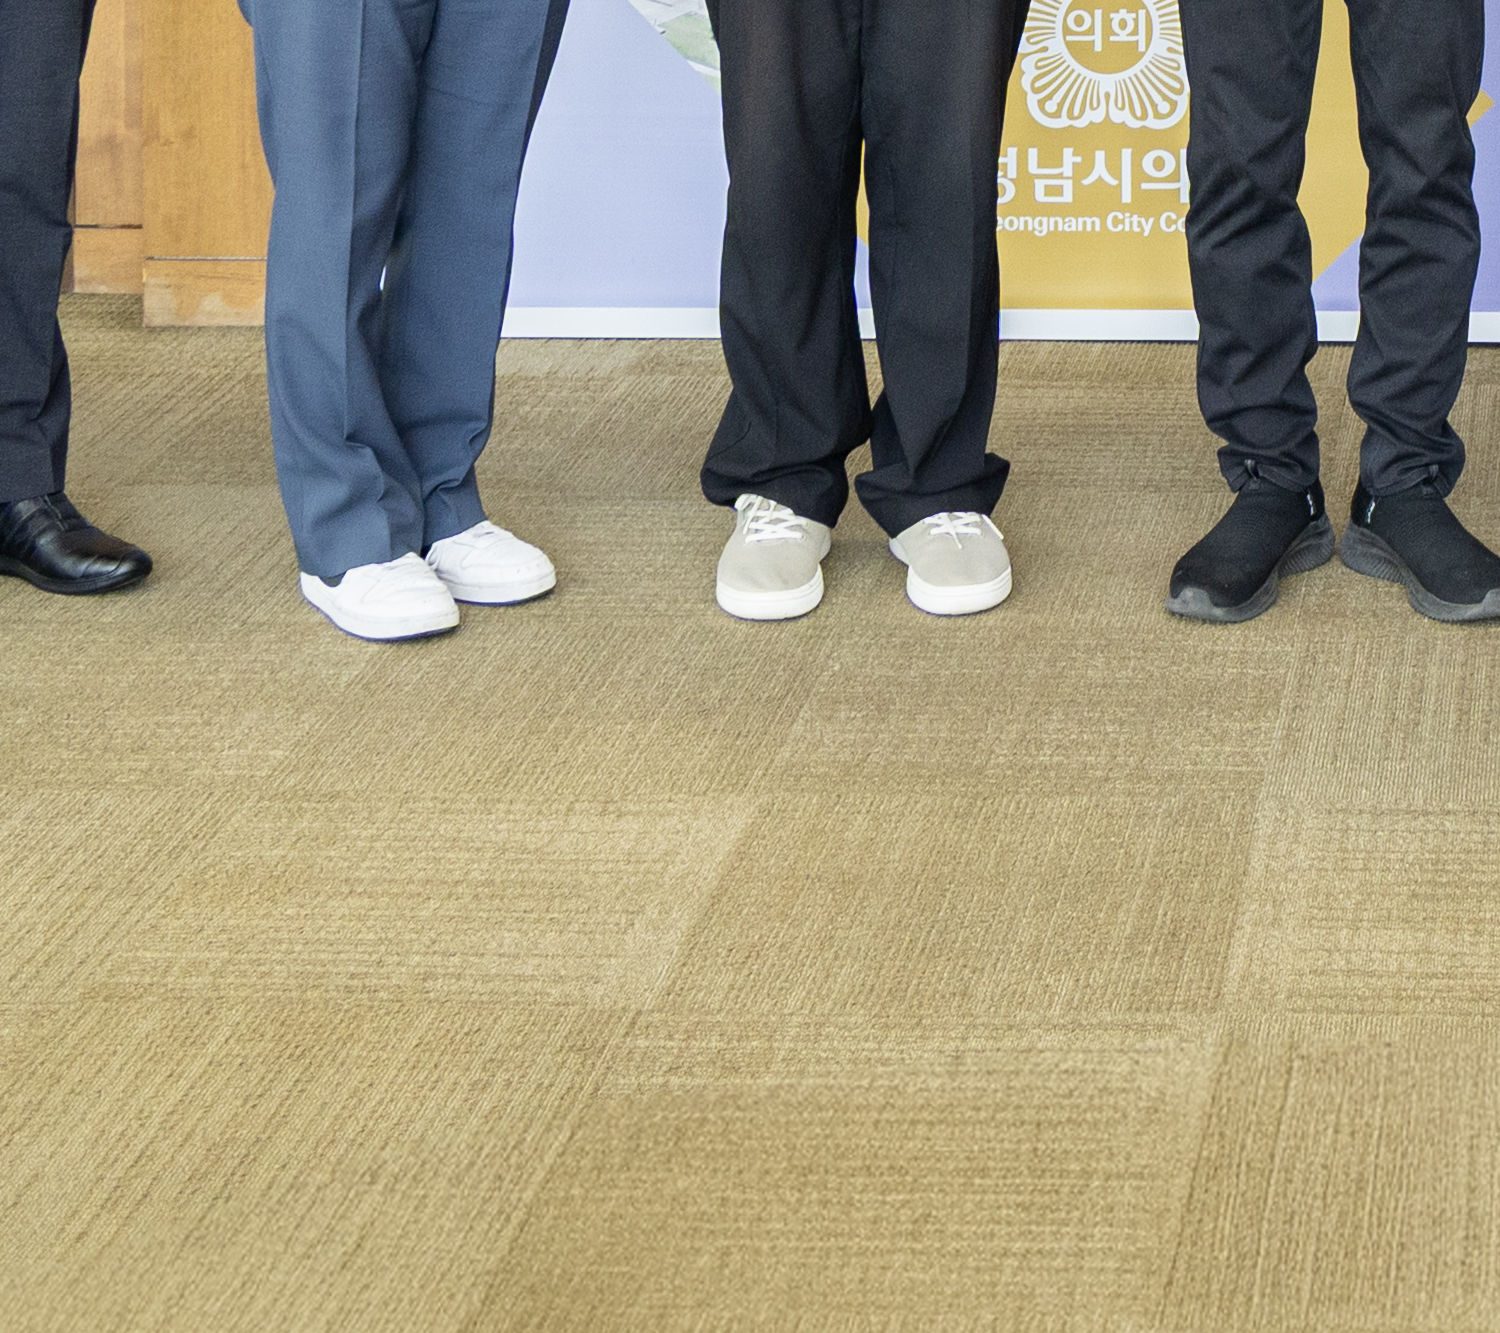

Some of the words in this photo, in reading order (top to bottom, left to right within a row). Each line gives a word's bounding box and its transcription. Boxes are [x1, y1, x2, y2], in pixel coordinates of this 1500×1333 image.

[1066, 8, 1147, 52] 의회
[997, 213, 1100, 237] eongnam
[1106, 211, 1154, 237] City
